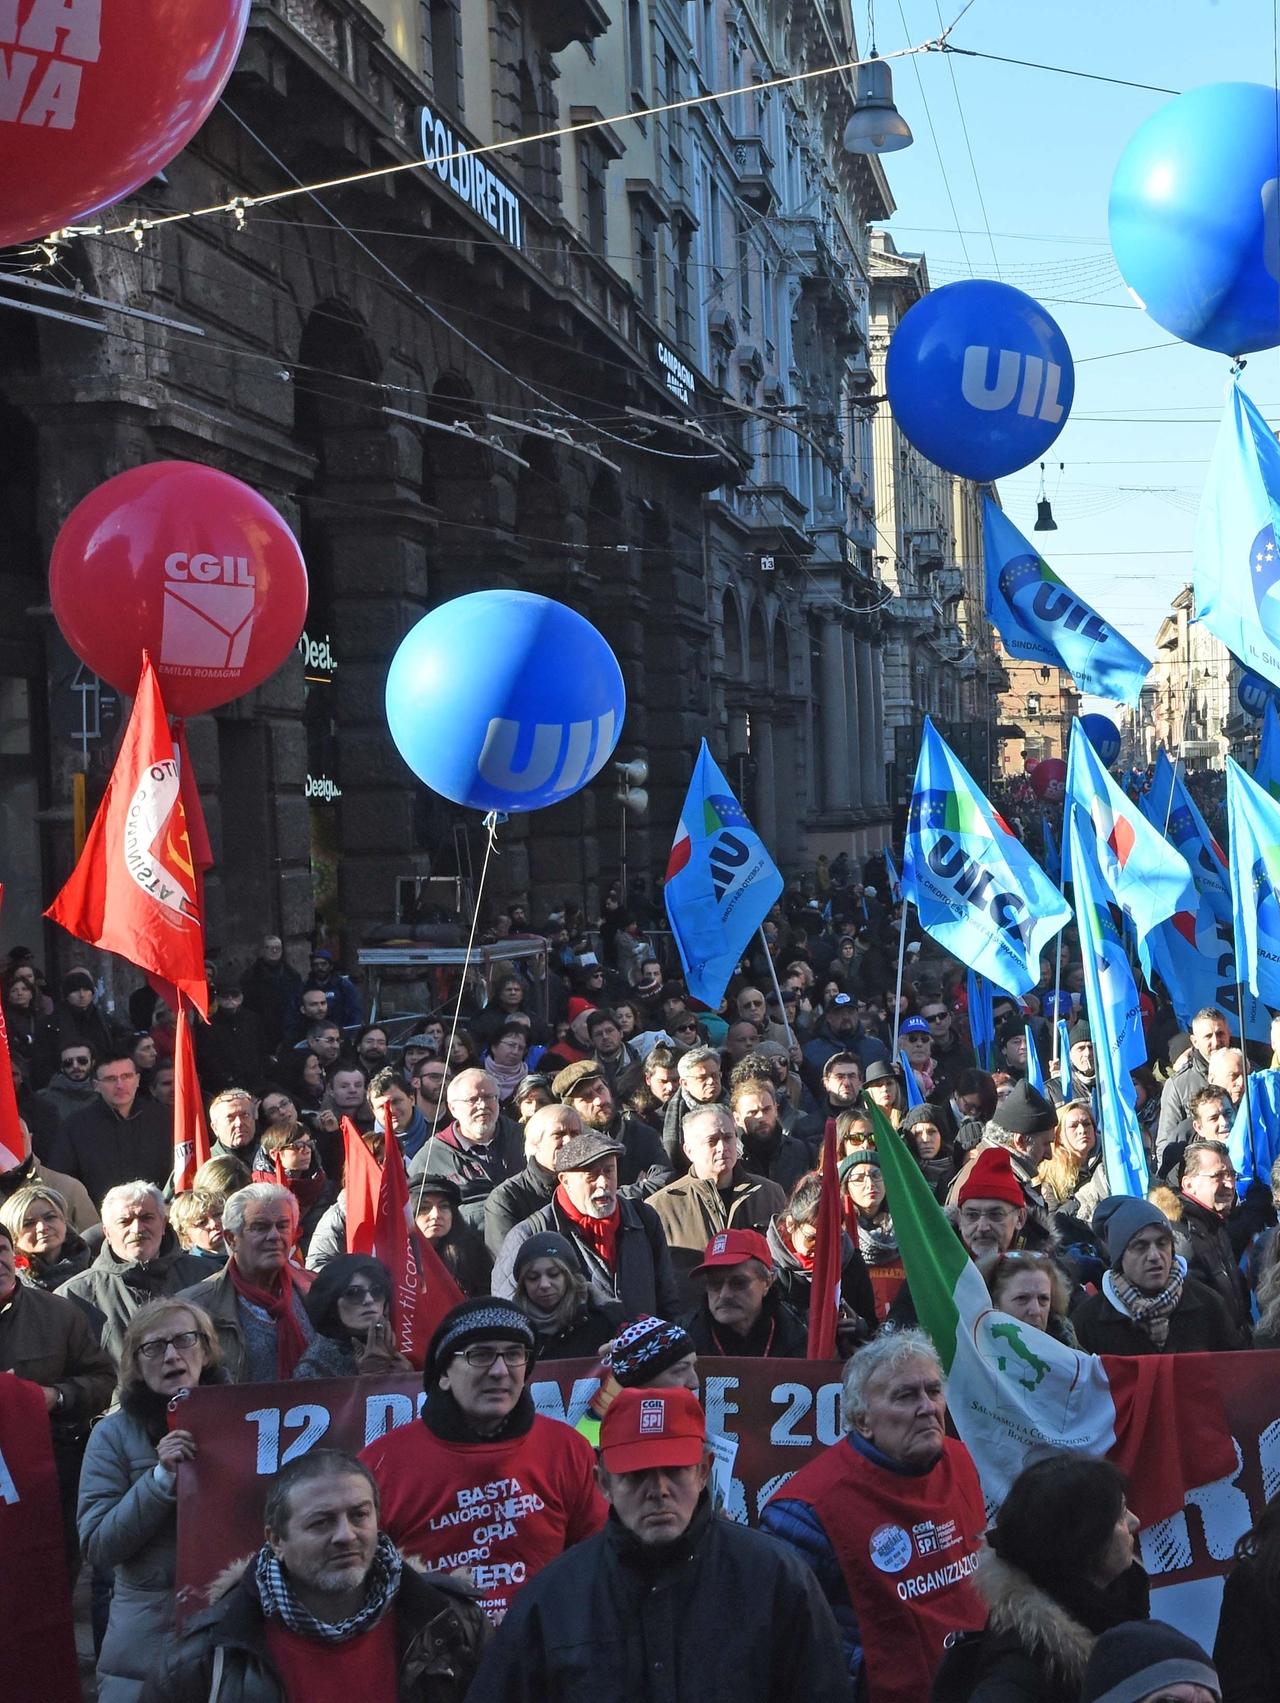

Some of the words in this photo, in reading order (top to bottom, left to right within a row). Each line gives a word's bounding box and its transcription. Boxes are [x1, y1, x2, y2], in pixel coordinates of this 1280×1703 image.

[421, 106, 521, 250] COLDIRETTI
[658, 342, 695, 393] CAMPAGNA
[667, 371, 689, 406] AMICA
[962, 345, 1064, 424] UIL
[165, 552, 256, 586] CGIL
[762, 561, 774, 569] 13
[158, 665, 193, 677] EMILIA
[194, 666, 241, 679] ROMAGNA
[924, 880, 952, 907] CREDITO
[642, 1400, 663, 1409] CGIL
[642, 1414, 662, 1428] SPI
[245, 1404, 331, 1475] 12
[456, 1477, 523, 1510] BASTA
[429, 1503, 492, 1531] LAVORO
[493, 1493, 545, 1522] NERO
[472, 1520, 519, 1546] ORA
[912, 1520, 935, 1534] CGIL
[426, 1545, 491, 1571] LAVORO
[917, 1536, 938, 1555] SPI
